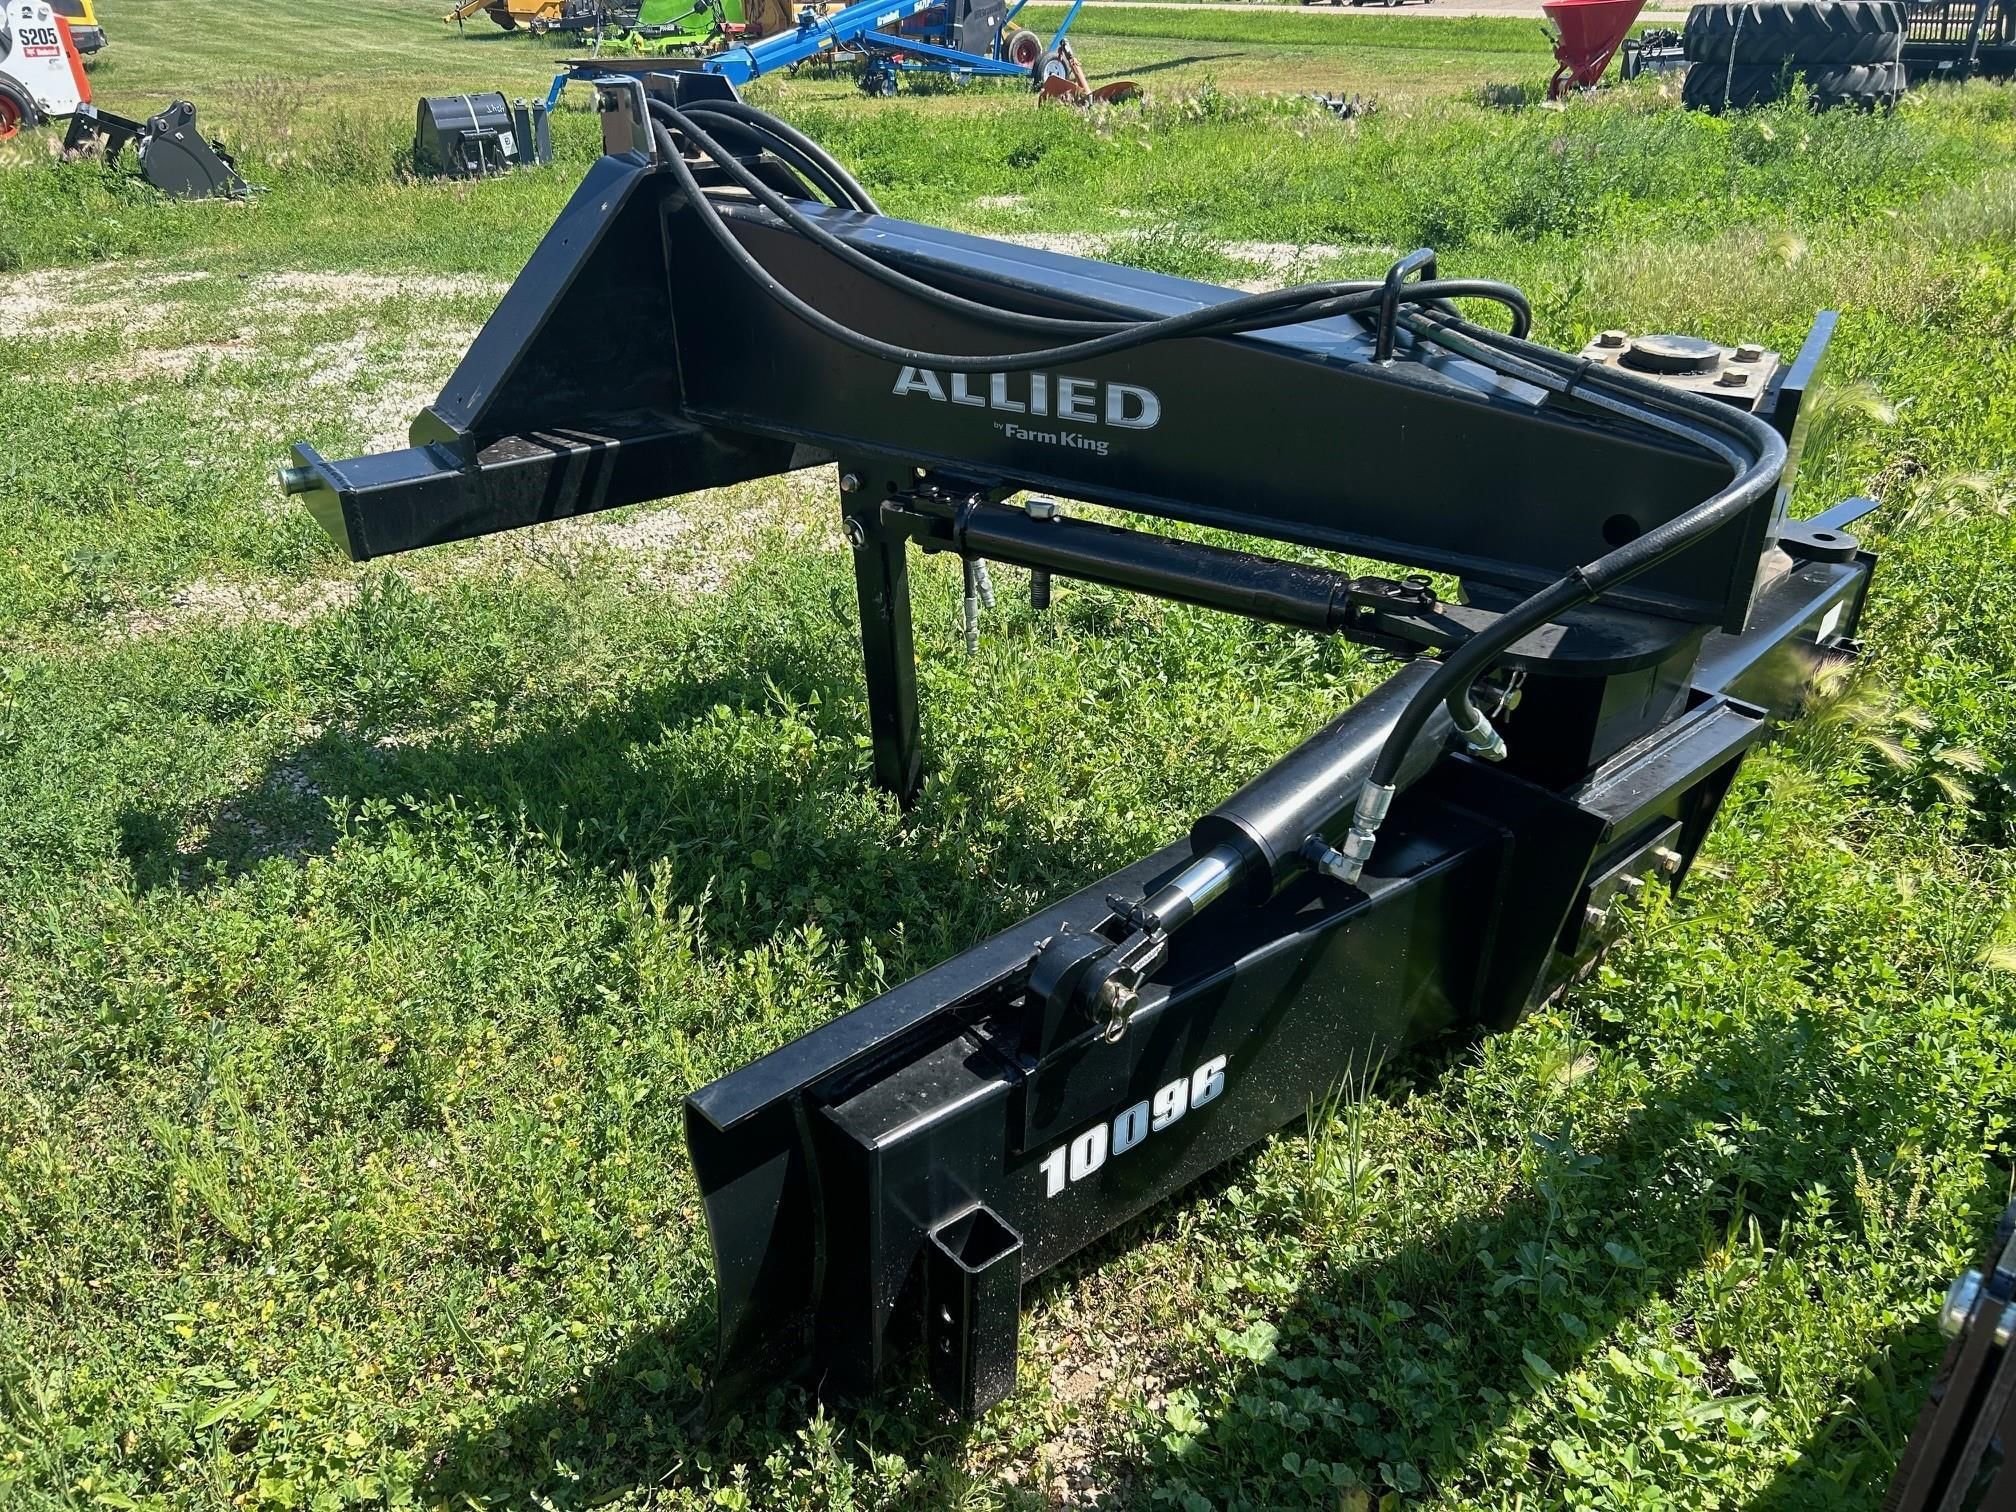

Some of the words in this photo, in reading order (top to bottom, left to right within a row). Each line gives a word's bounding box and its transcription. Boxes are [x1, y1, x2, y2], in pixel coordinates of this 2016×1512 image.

[19, 27, 58, 46] S205
[892, 365, 1161, 430] ALLIED
[993, 421, 1004, 430] by
[1005, 423, 1057, 444] Farm
[1060, 431, 1110, 456] King
[1039, 1053, 1228, 1199] 10096
